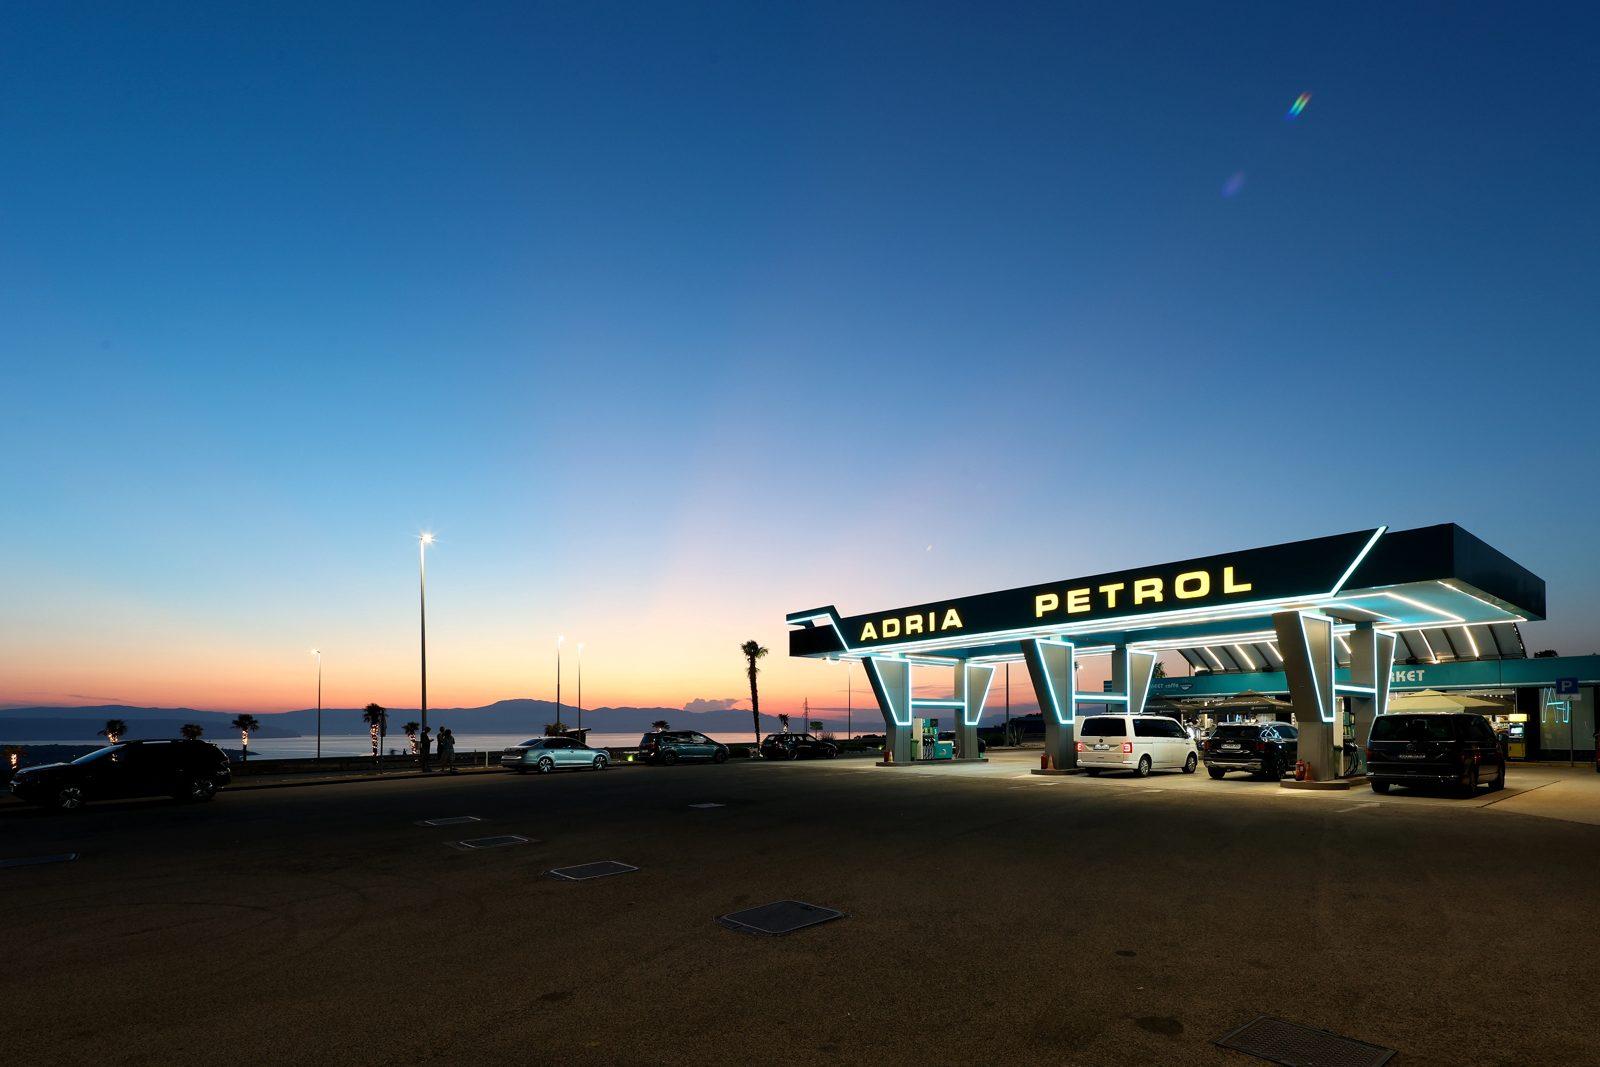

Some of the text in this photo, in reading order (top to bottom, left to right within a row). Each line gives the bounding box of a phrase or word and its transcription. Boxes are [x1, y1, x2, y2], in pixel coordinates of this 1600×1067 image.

[860, 566, 1252, 641] ADRIA PETROL
[1561, 680, 1573, 692] P
